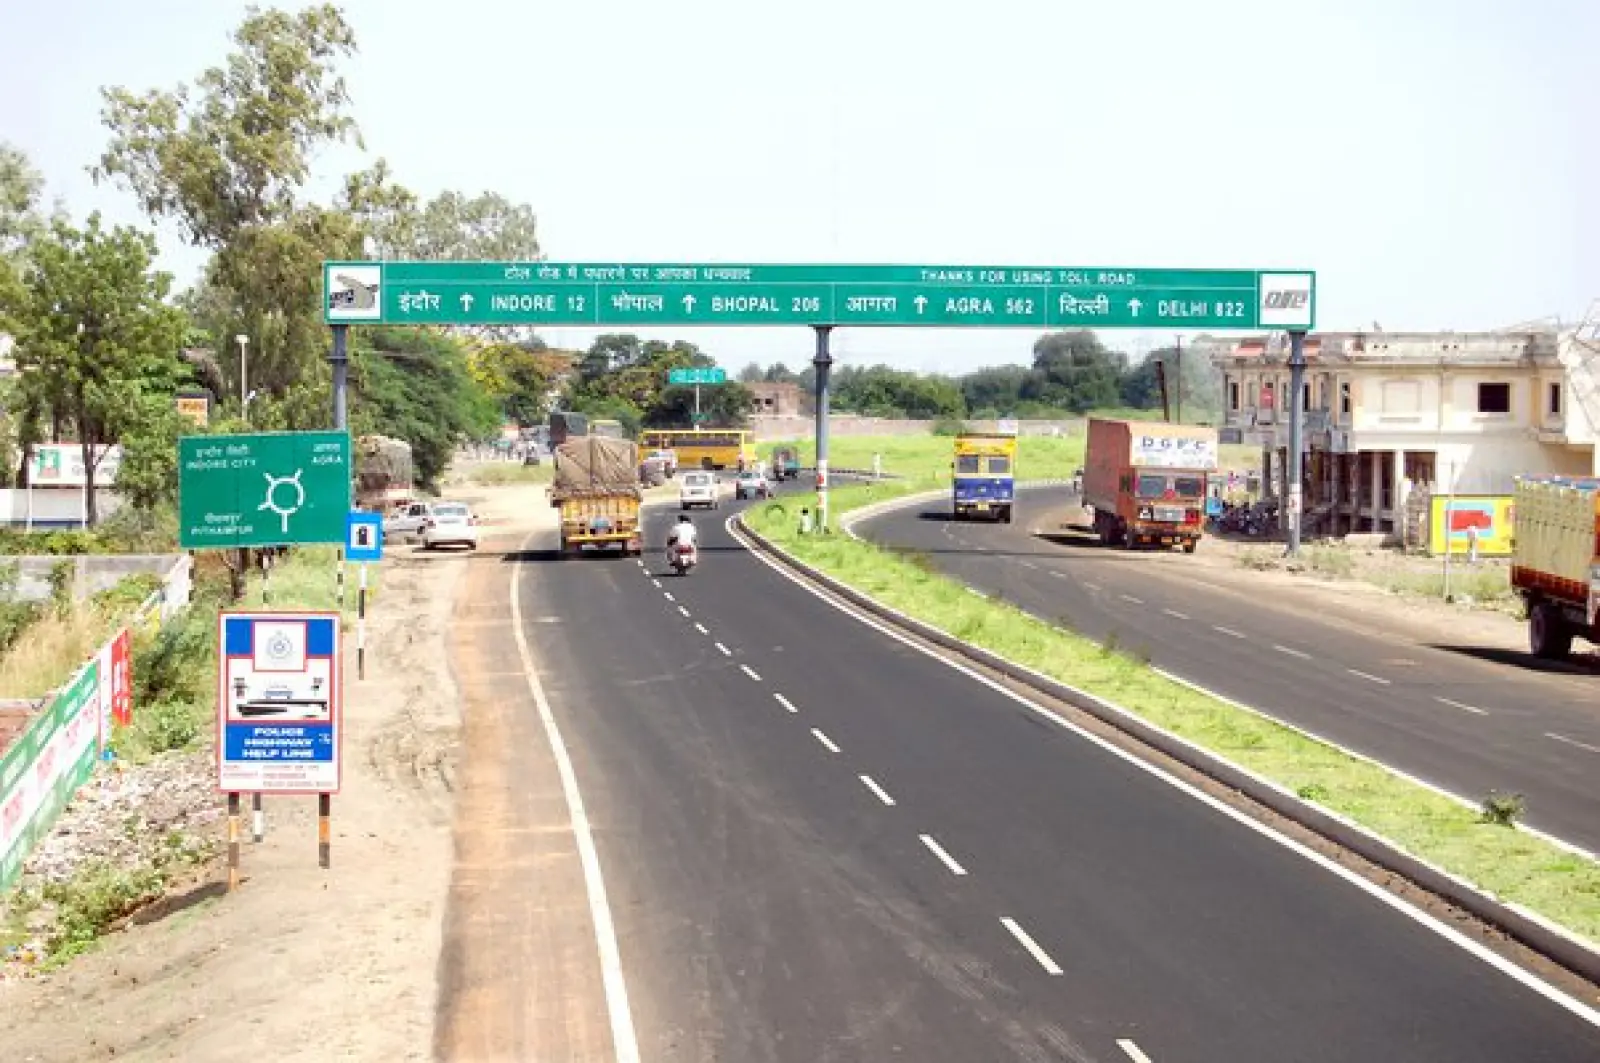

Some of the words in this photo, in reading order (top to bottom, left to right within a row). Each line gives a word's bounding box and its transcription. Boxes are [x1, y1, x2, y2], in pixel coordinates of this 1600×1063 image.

[631, 267, 650, 280] पर
[920, 270, 974, 283] THANKS
[980, 271, 1006, 283] FOR
[1012, 271, 1053, 283] USING
[1059, 272, 1090, 284] TOLL
[1097, 273, 1136, 285] ROAD
[397, 289, 442, 313] इंदौर
[490, 295, 557, 312] INDORE
[567, 295, 585, 312] 12
[611, 290, 664, 313] भोपाल
[711, 296, 780, 313] BHOPAL
[847, 296, 897, 313] आगरा
[945, 297, 994, 314] AGRA
[1059, 292, 1109, 315] दिल्ली
[1157, 300, 1208, 317] DELHI
[186, 459, 228, 470] INDORE
[230, 458, 256, 469] CITY
[311, 455, 344, 465] AGRA
[253, 728, 304, 736] POLICE
[242, 749, 280, 758] HELP
[281, 749, 314, 758] LINE
